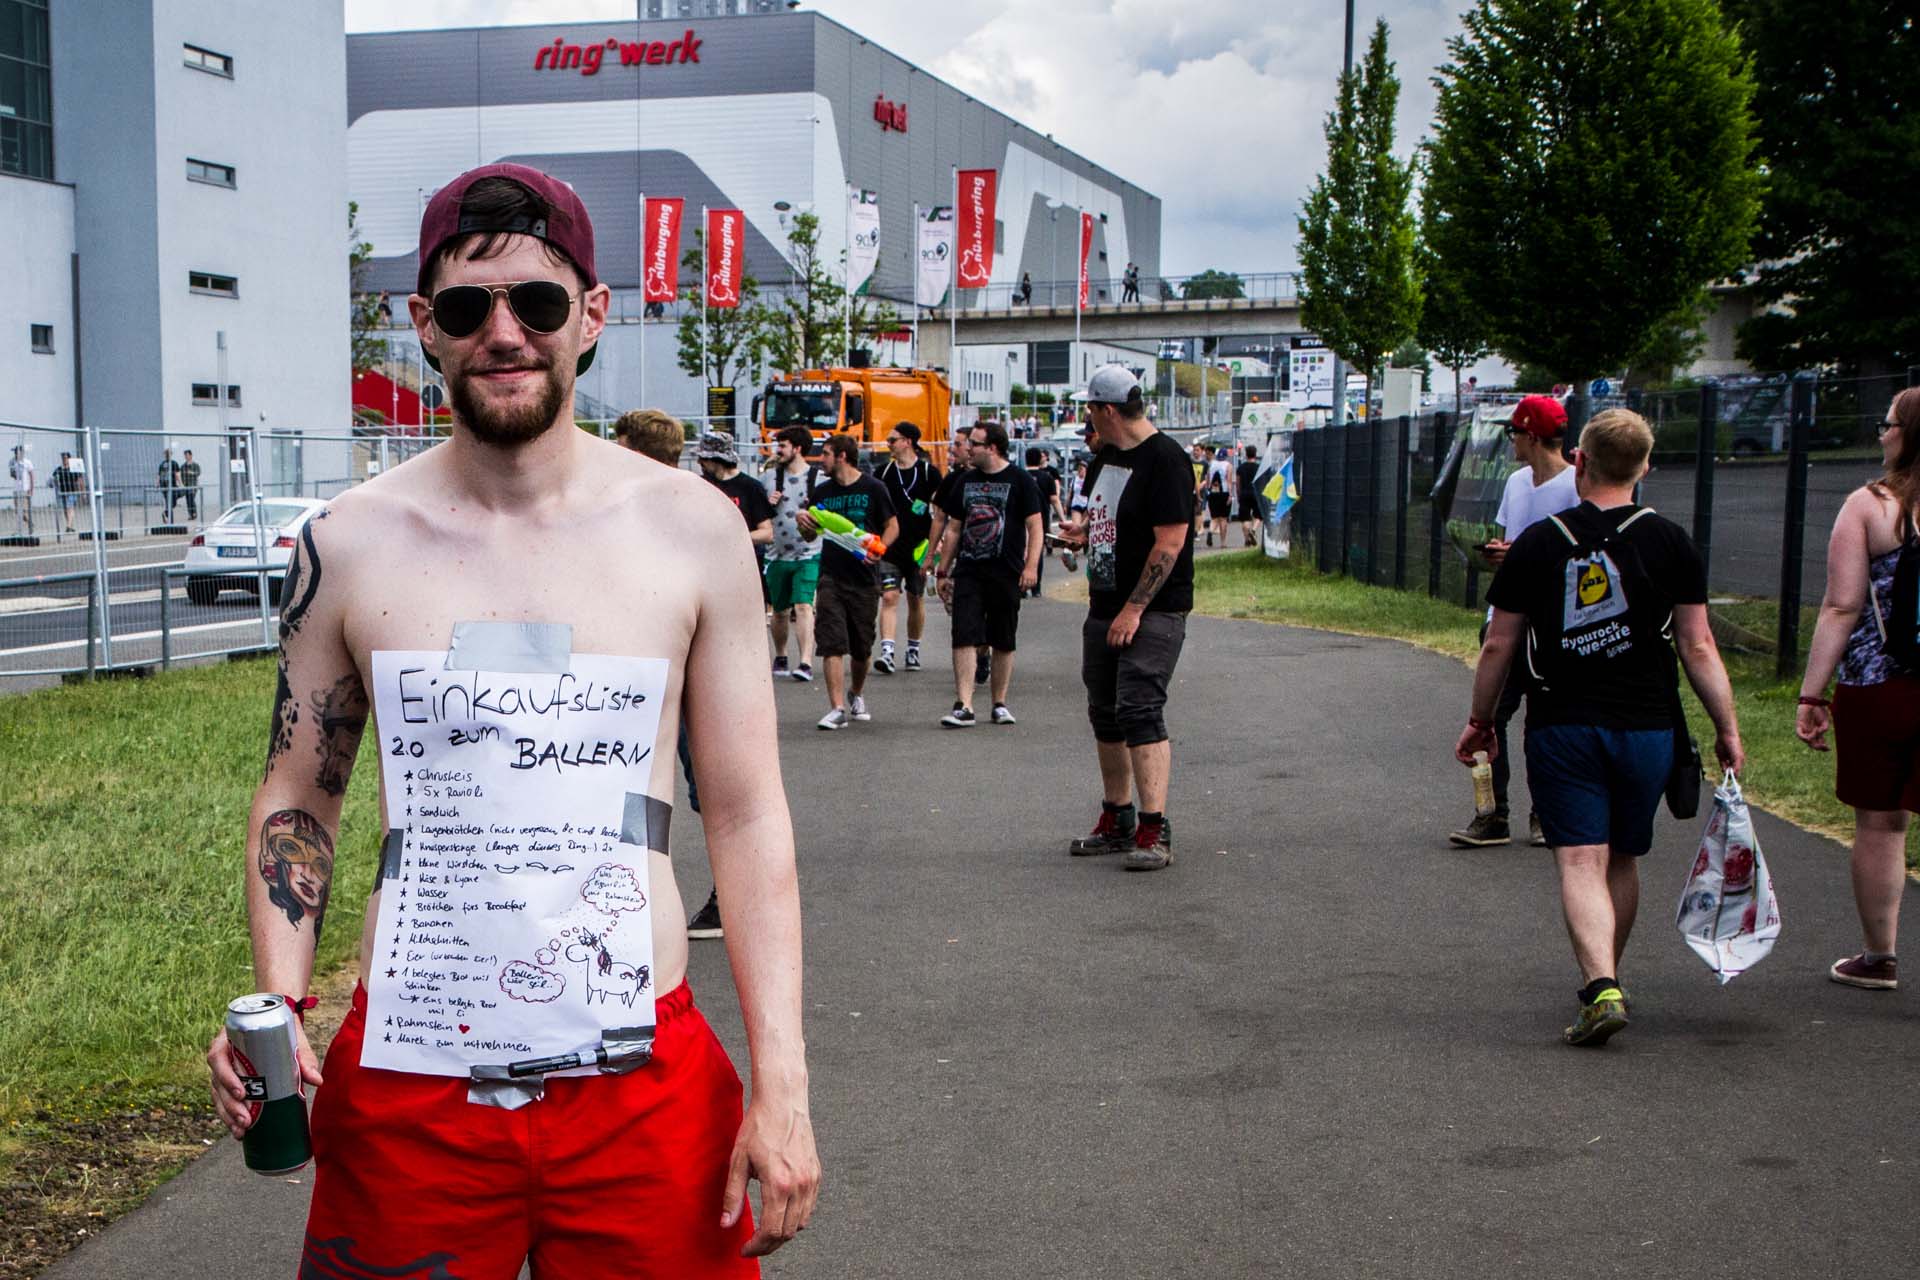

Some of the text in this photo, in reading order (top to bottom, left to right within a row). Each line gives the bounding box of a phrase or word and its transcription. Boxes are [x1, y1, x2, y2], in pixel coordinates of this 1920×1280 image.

[534, 29, 703, 76] ring°werk
[971, 175, 986, 262] nürburgring
[654, 203, 673, 279] nürburgring
[719, 215, 735, 286] nürburgring
[801, 384, 832, 393] MAN
[1561, 621, 1619, 649] #yourock
[1578, 625, 1631, 656] wecare
[392, 725, 651, 773] 2.0 zum BALLERN
[445, 785, 483, 799] Ravioli
[419, 805, 460, 818] Sandwich
[417, 887, 449, 899] Wasser
[410, 918, 454, 929] Bananen
